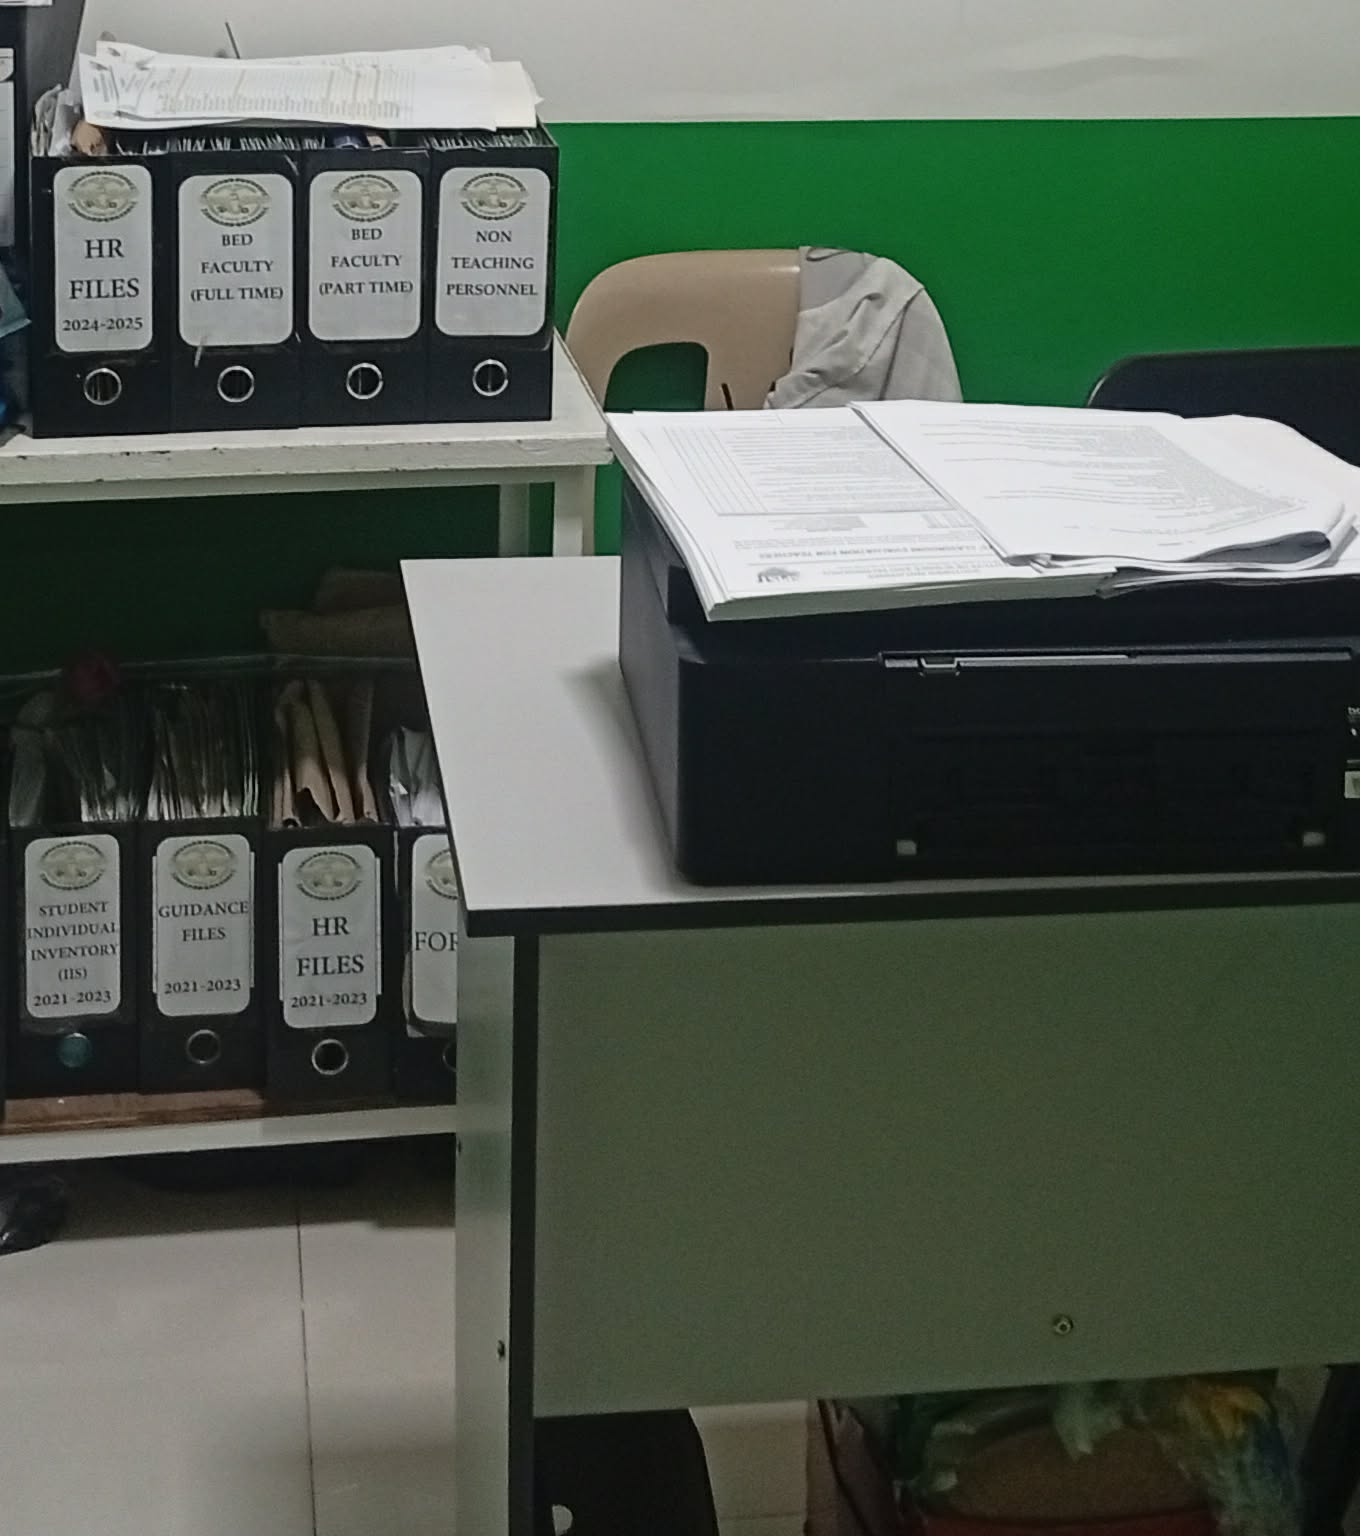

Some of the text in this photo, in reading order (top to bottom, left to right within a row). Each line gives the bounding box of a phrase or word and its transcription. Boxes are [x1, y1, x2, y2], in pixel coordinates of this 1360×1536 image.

[221, 233, 253, 247] BED
[351, 228, 383, 241] BED
[475, 230, 513, 243] NON
[84, 238, 124, 259] HR
[200, 260, 274, 275] FACULTY
[330, 254, 402, 269] FACULTY
[451, 256, 535, 270] TEACHING
[69, 278, 140, 300] FILES
[190, 286, 284, 302] (FULL TIME)
[319, 280, 414, 296] (PART TIME)
[446, 283, 538, 296] PERSONNEL
[62, 317, 144, 332] 2024-2025
[39, 901, 109, 917] STUDENT
[158, 901, 249, 919] GUIDANCE
[27, 922, 117, 939] INDIVIDUAL
[311, 916, 351, 937] HR
[182, 927, 226, 943] FILES
[31, 943, 118, 961] INVENTORY
[296, 954, 365, 977] FILES
[58, 967, 87, 983] (IIS)
[164, 978, 241, 995] 2021-2023
[33, 990, 112, 1007] 2021-2023
[291, 992, 368, 1009] 2021-2023
